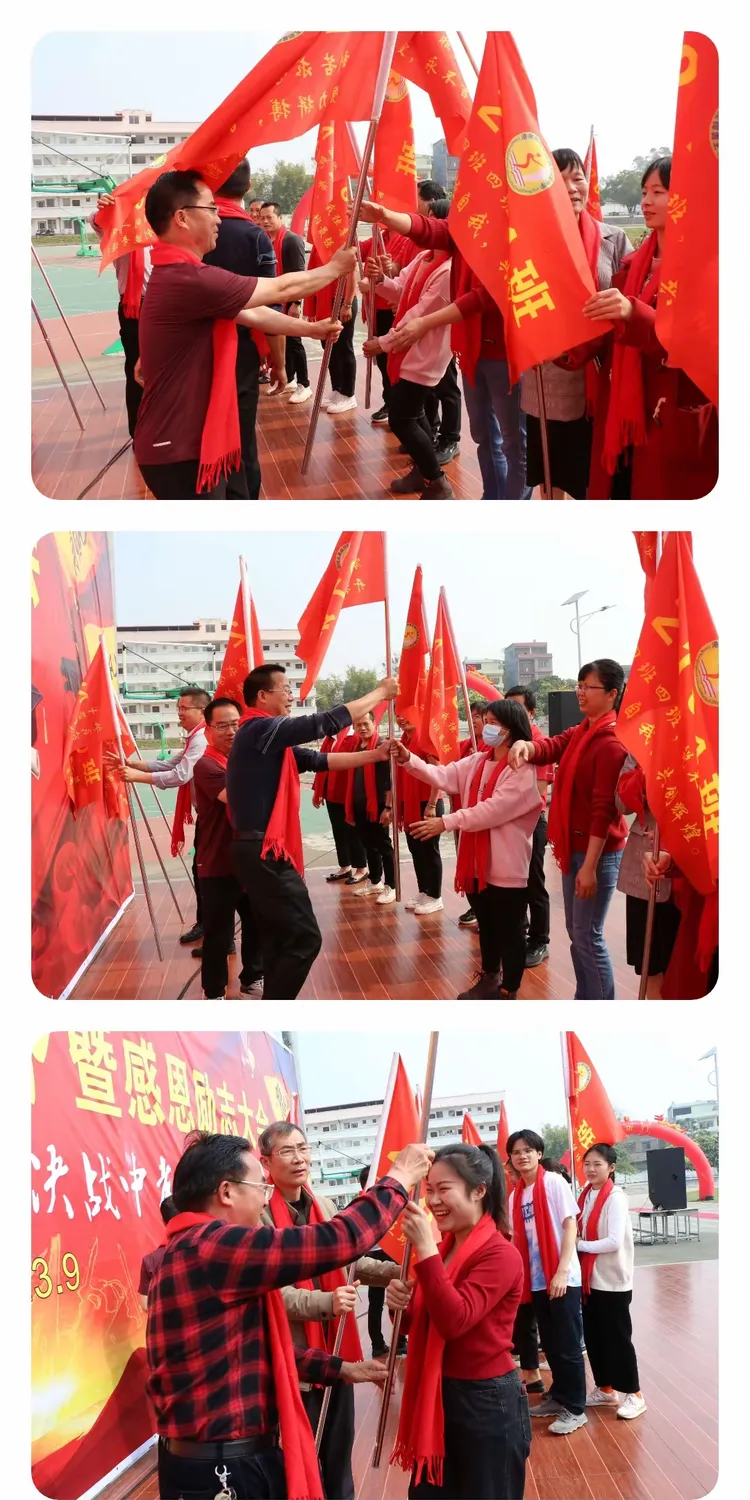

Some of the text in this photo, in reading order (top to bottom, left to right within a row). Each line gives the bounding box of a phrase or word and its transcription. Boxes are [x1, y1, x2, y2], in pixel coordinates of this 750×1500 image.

[32, 1031, 269, 1150] 暨感恩励志大会
